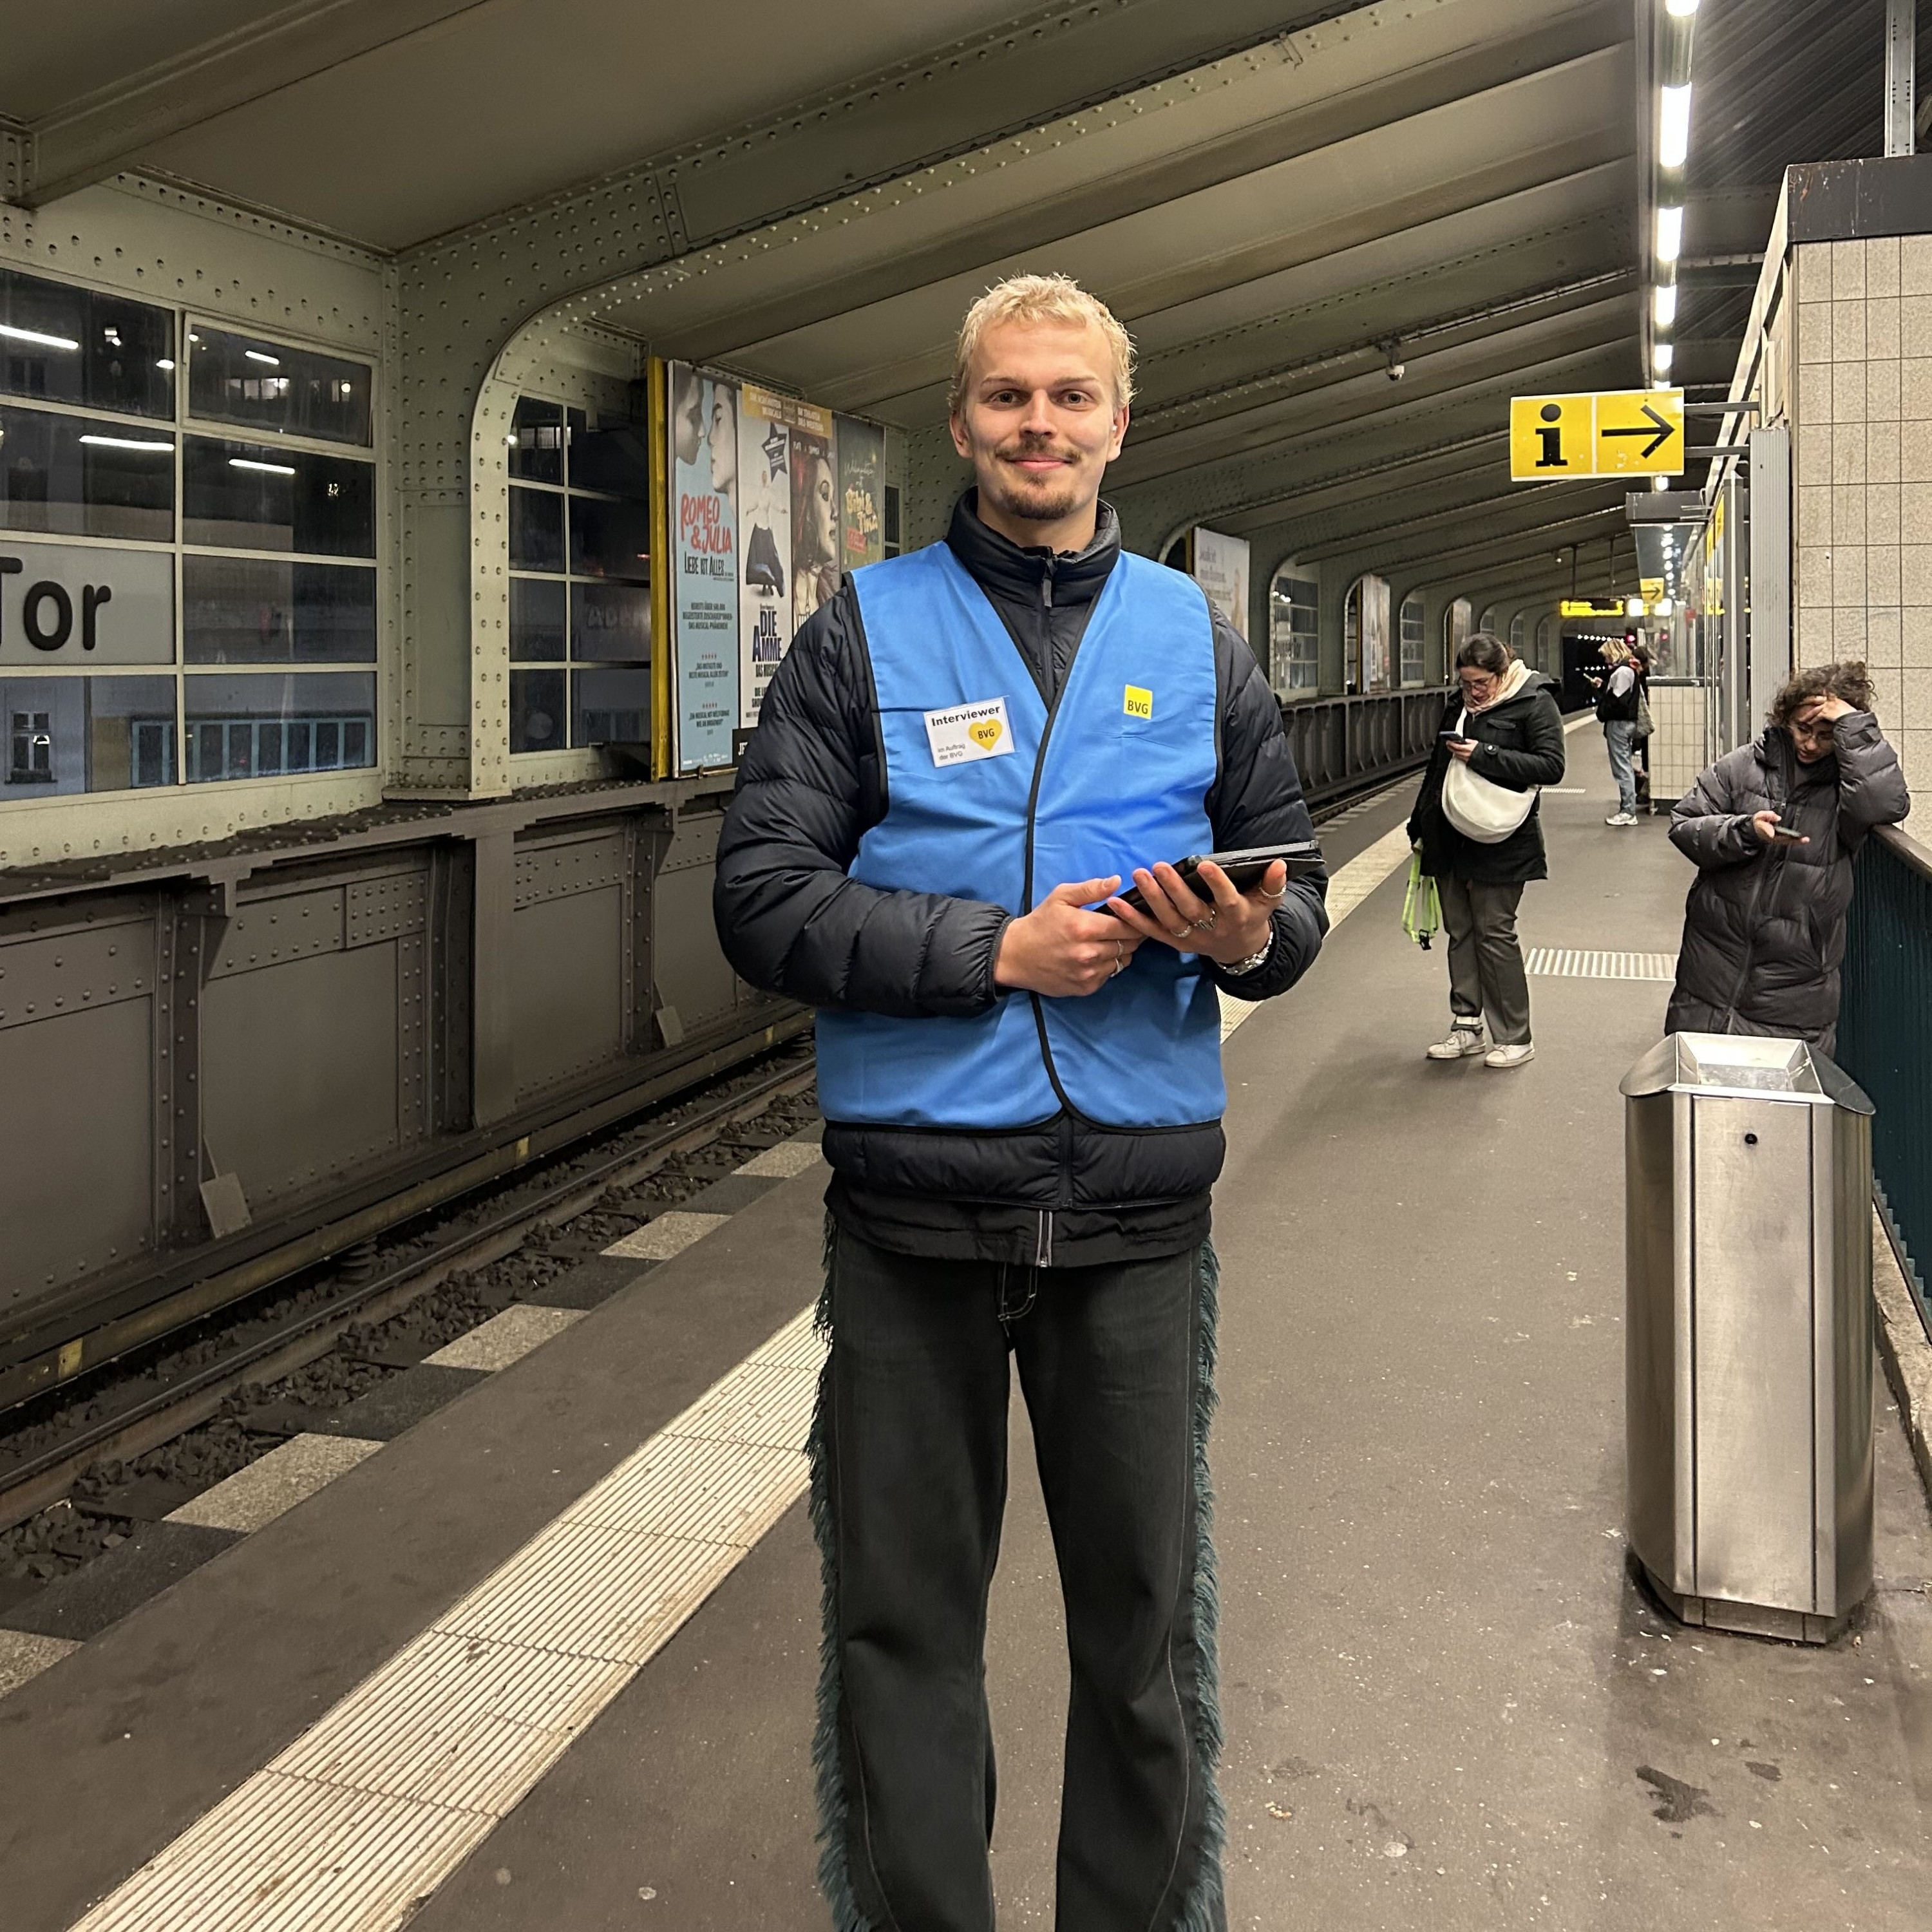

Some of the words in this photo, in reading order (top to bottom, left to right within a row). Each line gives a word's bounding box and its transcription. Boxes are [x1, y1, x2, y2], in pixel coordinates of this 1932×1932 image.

[680, 493, 720, 542] ROMEO
[690, 525, 701, 550] &
[702, 524, 732, 554] JULIA
[760, 611, 777, 637] DIE
[752, 625, 782, 662] AMME
[931, 706, 1001, 727] Interviewer
[1128, 700, 1149, 715] BVG
[978, 728, 995, 740] BVG
